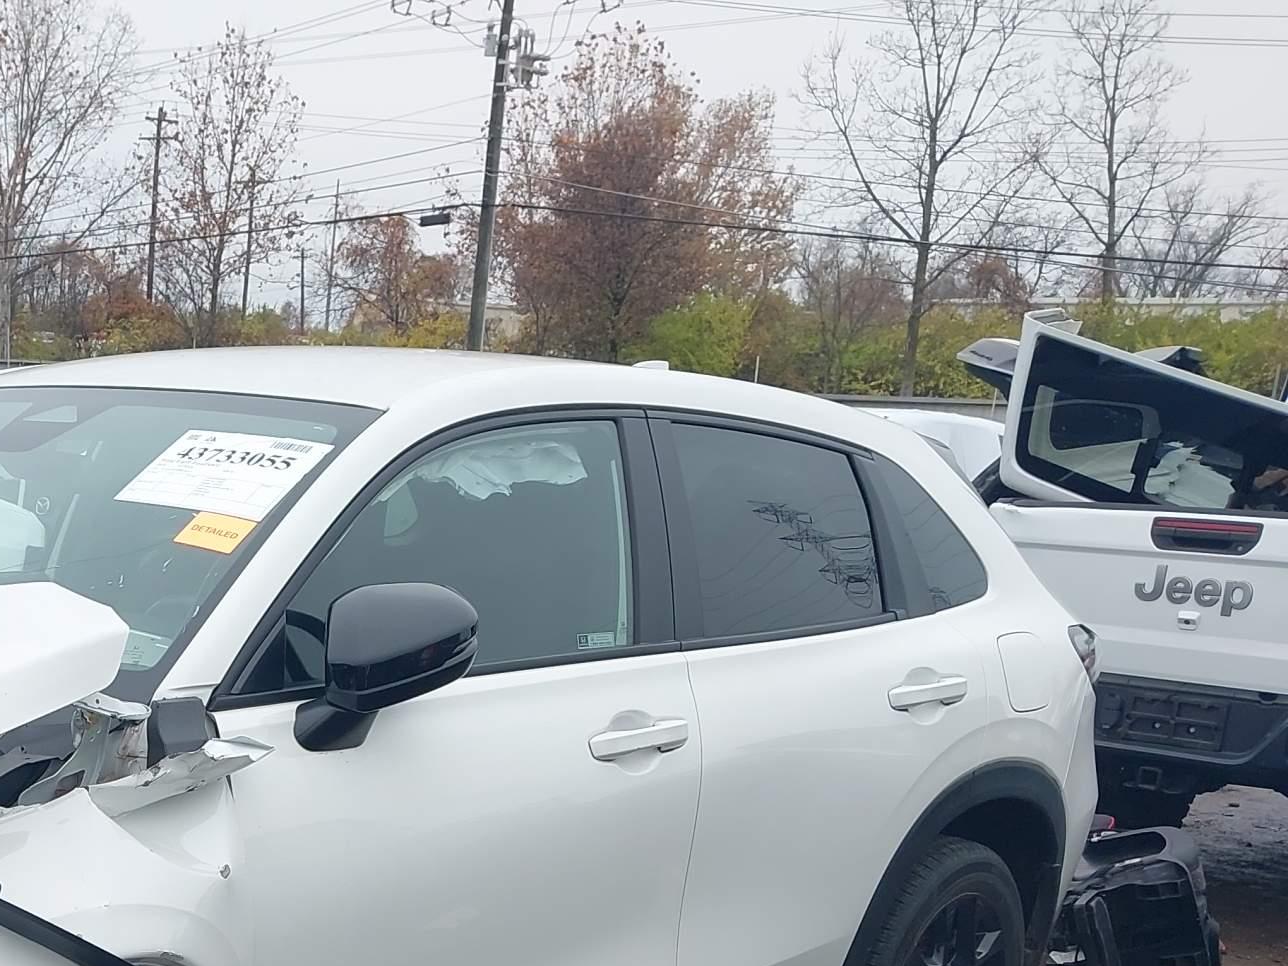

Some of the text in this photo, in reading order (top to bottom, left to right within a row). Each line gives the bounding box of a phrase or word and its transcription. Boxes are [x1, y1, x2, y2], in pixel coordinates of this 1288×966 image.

[177, 446, 297, 471] 43733055
[191, 523, 239, 540] DETAILED
[1134, 564, 1254, 617] Jeep
